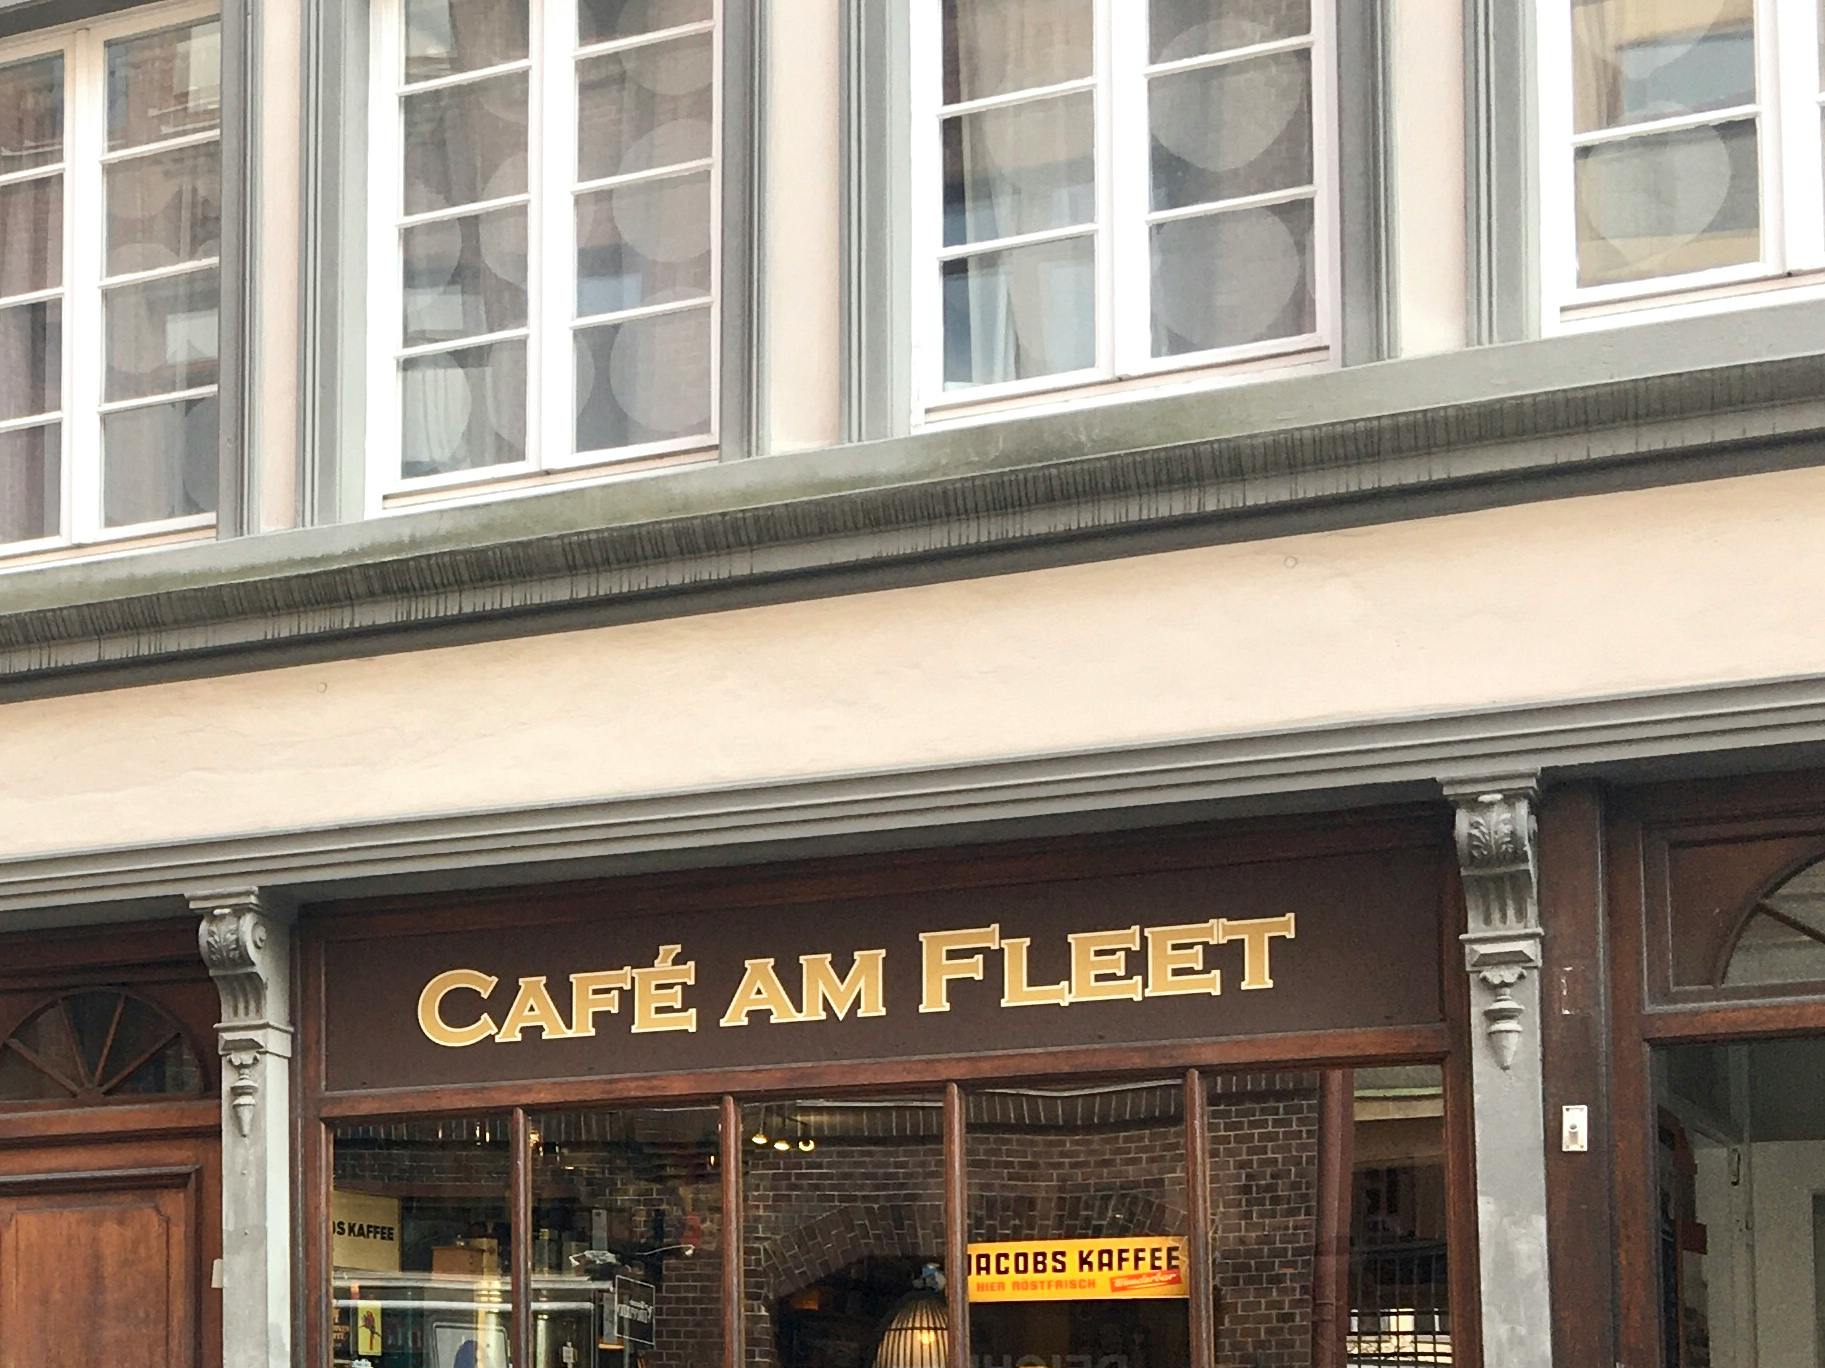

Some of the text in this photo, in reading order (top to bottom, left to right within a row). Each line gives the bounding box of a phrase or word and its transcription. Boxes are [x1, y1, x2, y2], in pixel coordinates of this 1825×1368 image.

[416, 912, 1296, 1048] CAFÉ AM FLEET
[348, 1221, 395, 1242] KAFFEE
[1078, 1245, 1180, 1272] KAFFEE
[976, 1281, 1006, 1293] HIER
